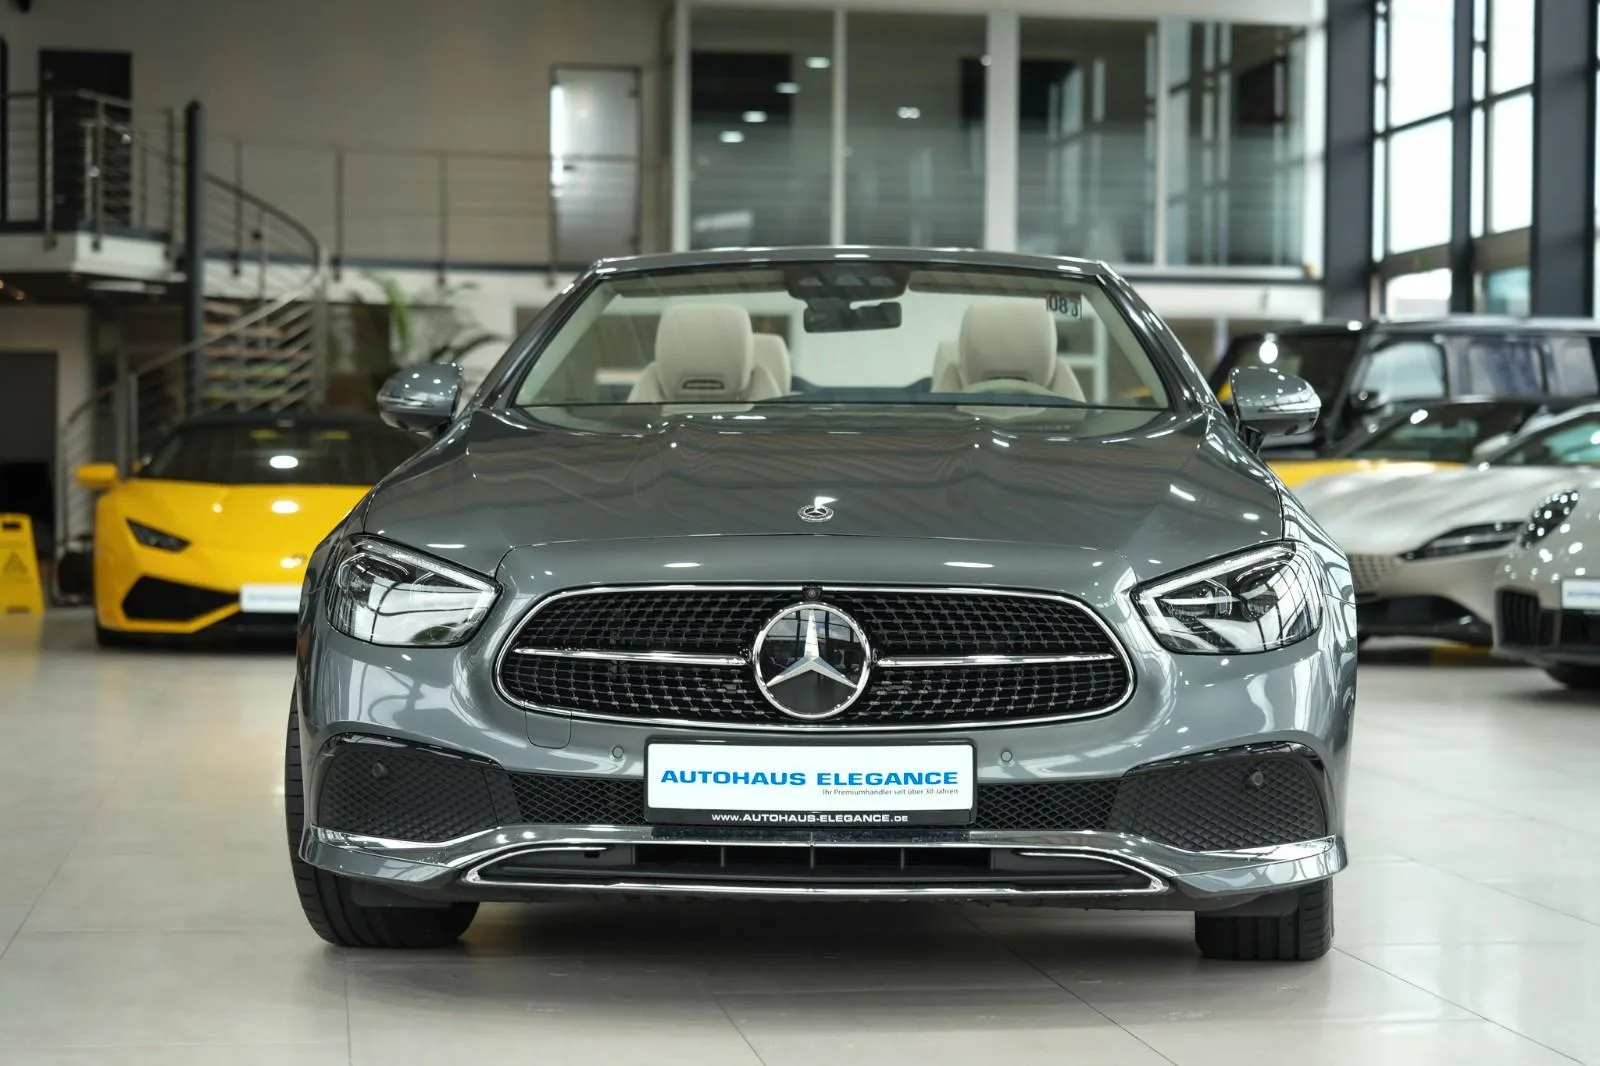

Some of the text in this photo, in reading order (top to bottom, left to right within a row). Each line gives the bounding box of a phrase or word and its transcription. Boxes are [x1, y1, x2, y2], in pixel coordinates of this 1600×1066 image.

[661, 770, 958, 786] AUTOHAUS ELEGANCE
[822, 788, 832, 796] Ihr
[834, 788, 892, 796] Premiumhändler
[894, 788, 906, 796] seit
[907, 788, 923, 796] über
[925, 788, 934, 796] 30
